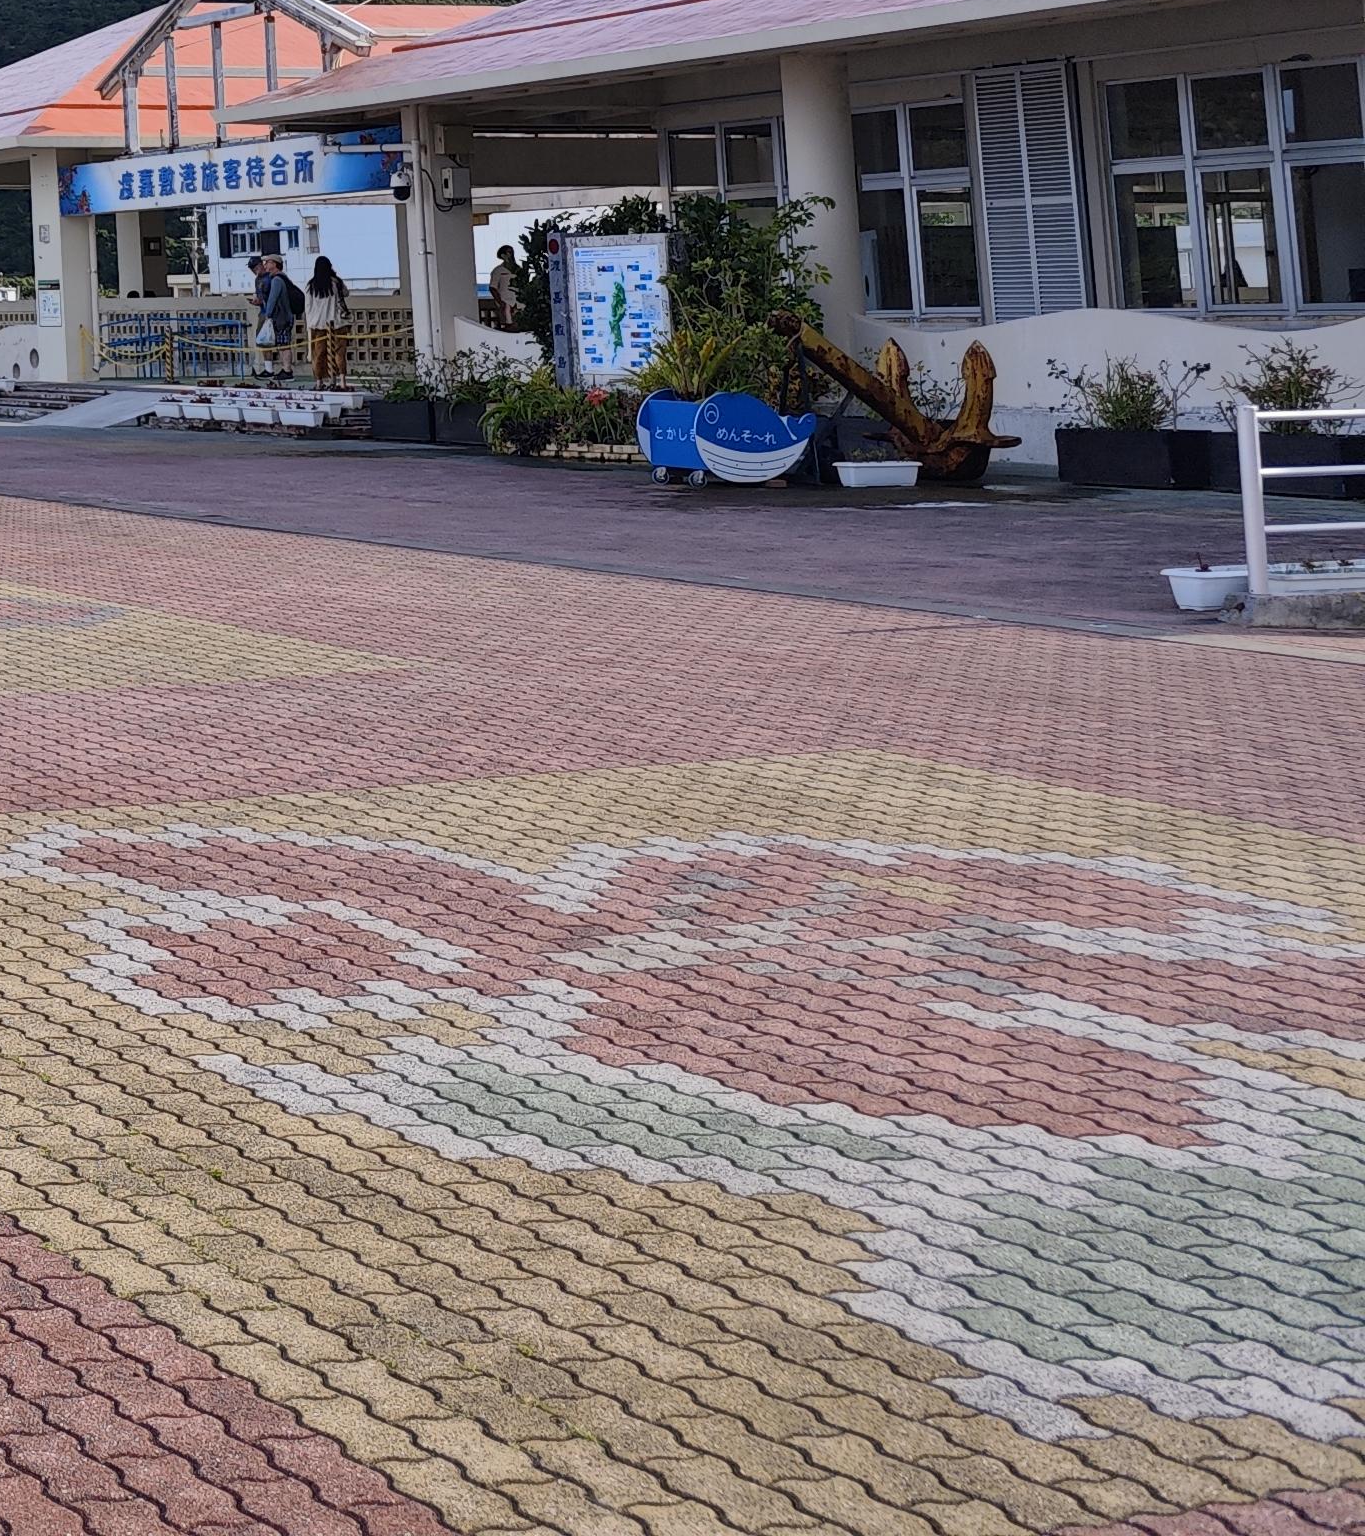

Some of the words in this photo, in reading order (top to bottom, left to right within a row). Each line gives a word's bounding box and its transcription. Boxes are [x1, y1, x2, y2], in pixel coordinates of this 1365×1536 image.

[118, 150, 314, 200] 渡嘉敷港旅客待合所
